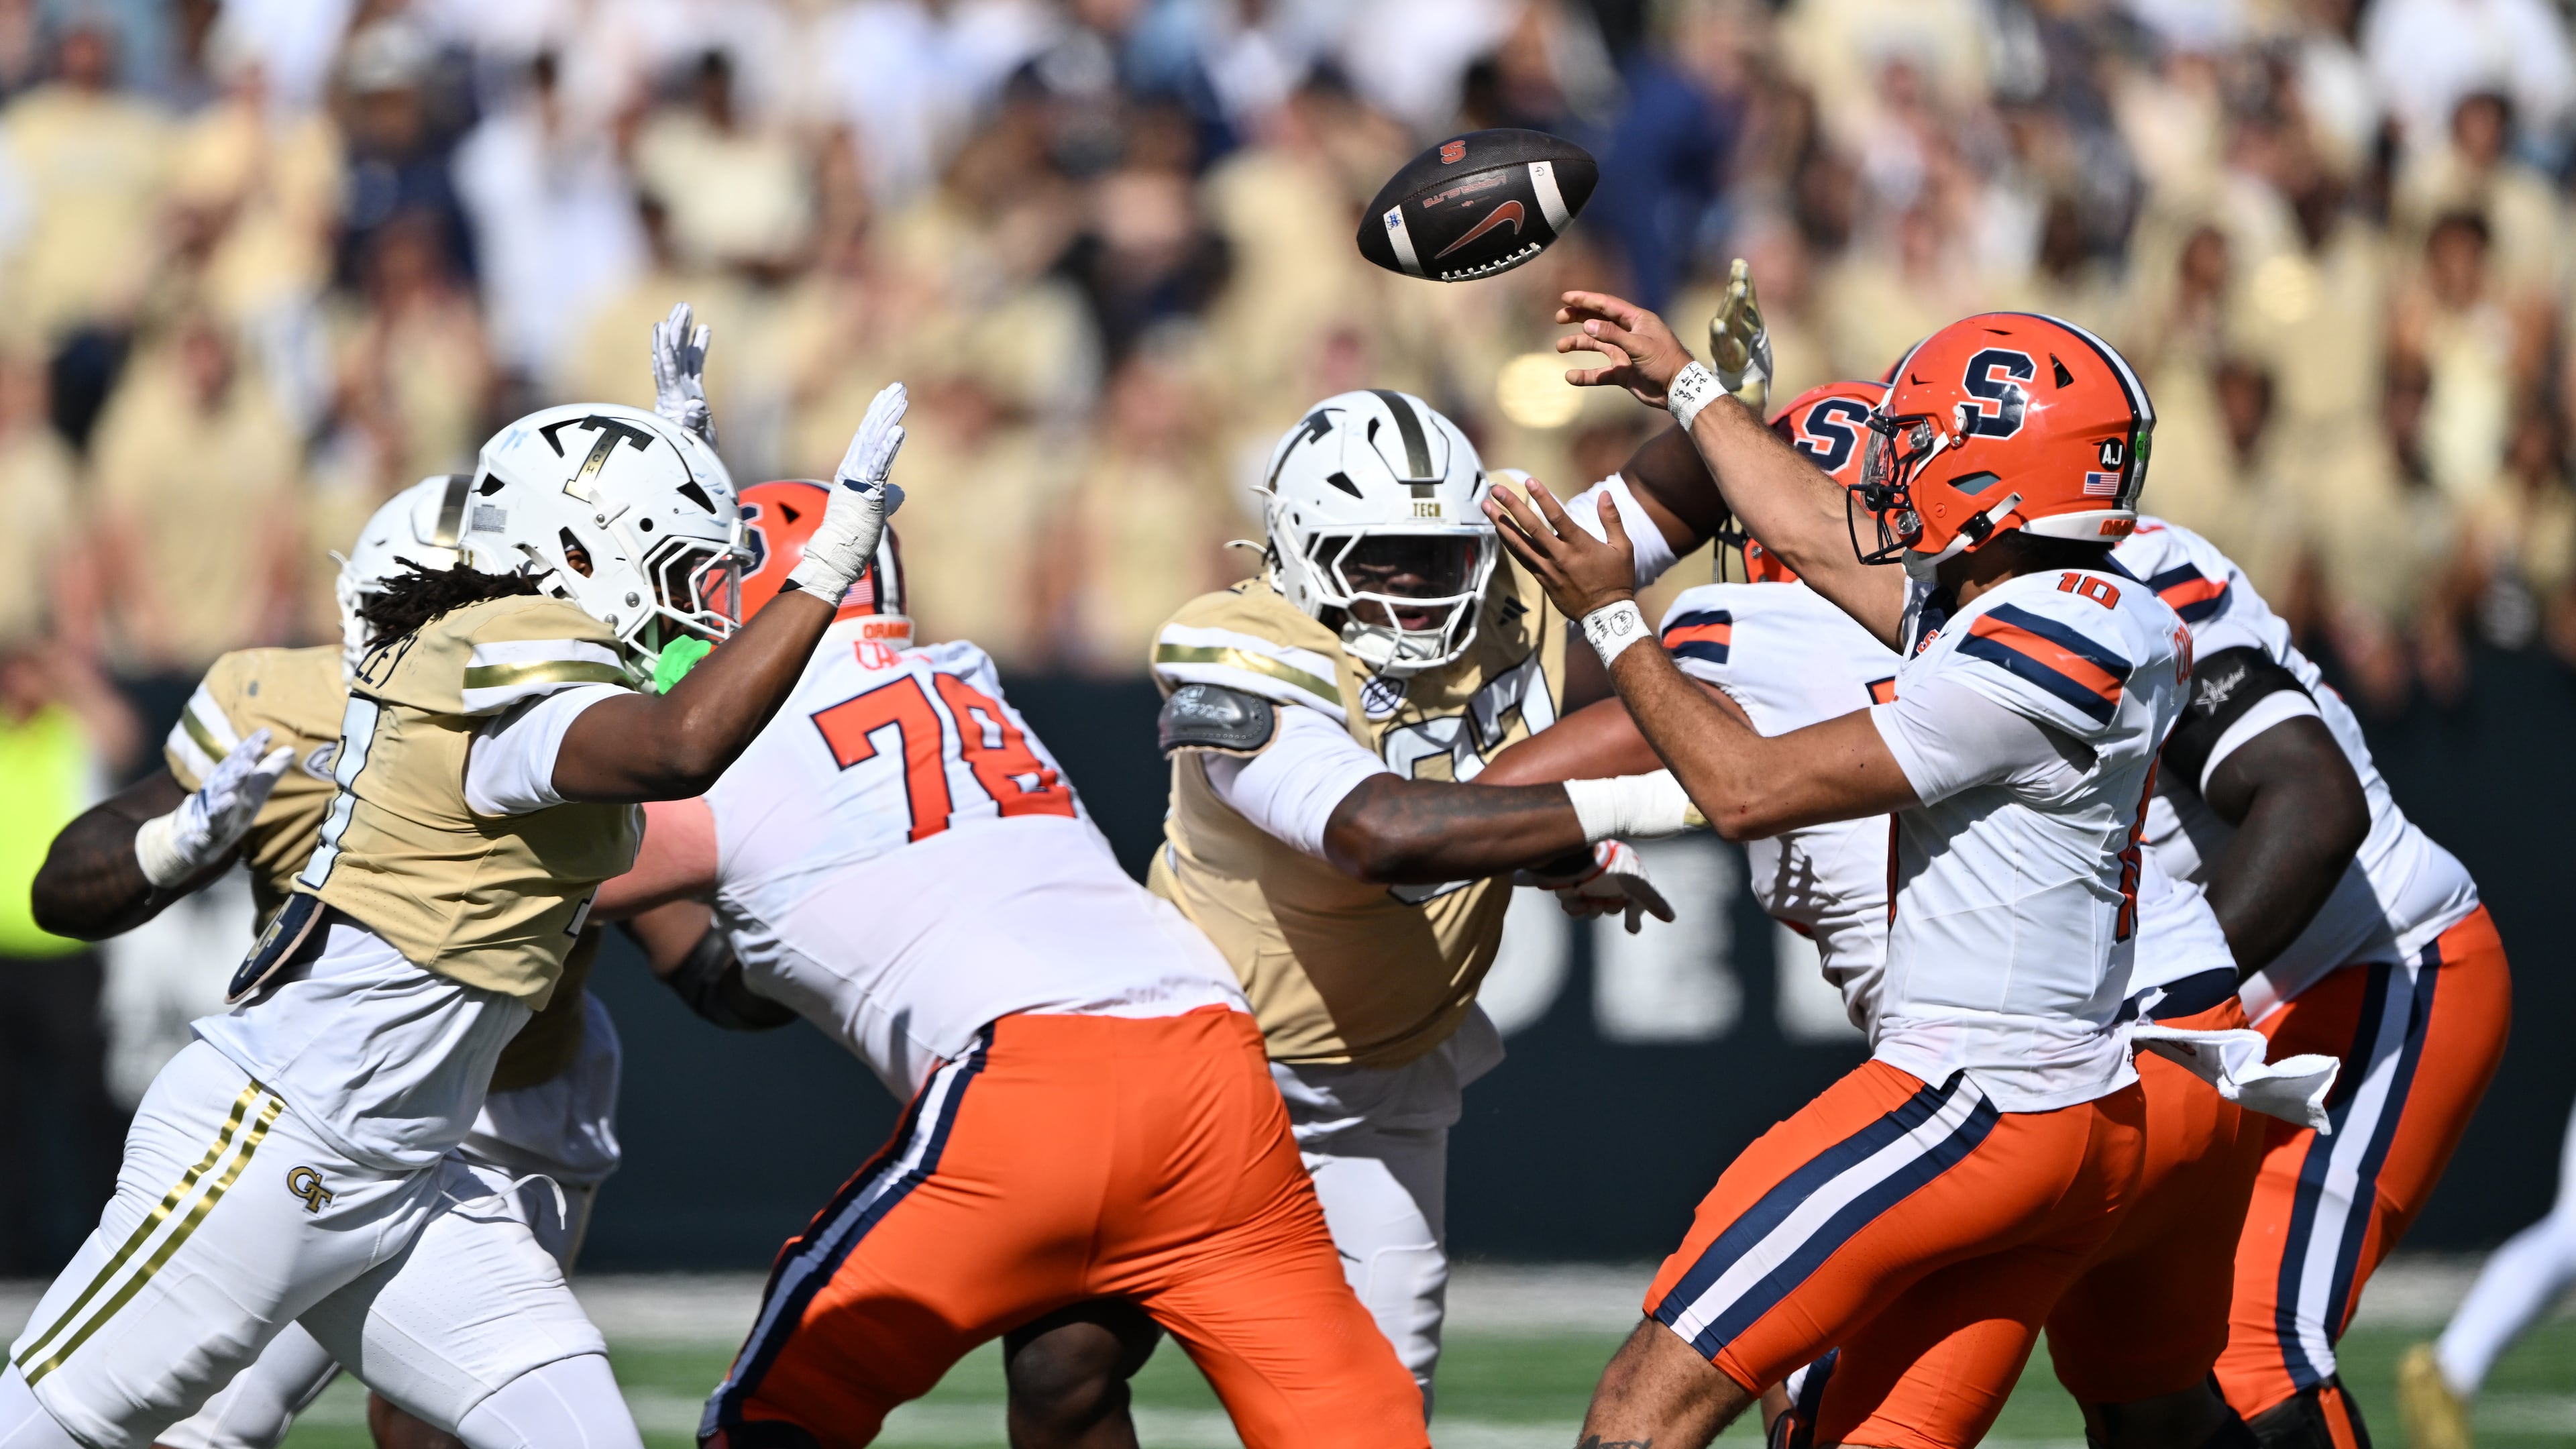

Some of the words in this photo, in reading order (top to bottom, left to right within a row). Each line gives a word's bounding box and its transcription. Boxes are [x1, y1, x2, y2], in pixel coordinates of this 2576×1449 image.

[1423, 188, 1460, 208] ELITE
[1957, 347, 2037, 440] S
[586, 435, 614, 474] TECH
[1793, 396, 1872, 476] S
[2101, 443, 2123, 465] AJ
[1413, 502, 1442, 517] TECH
[2057, 572, 2121, 610] 10
[1916, 629, 1941, 655] S
[810, 673, 1077, 844] 78
[286, 1166, 333, 1214] GT
